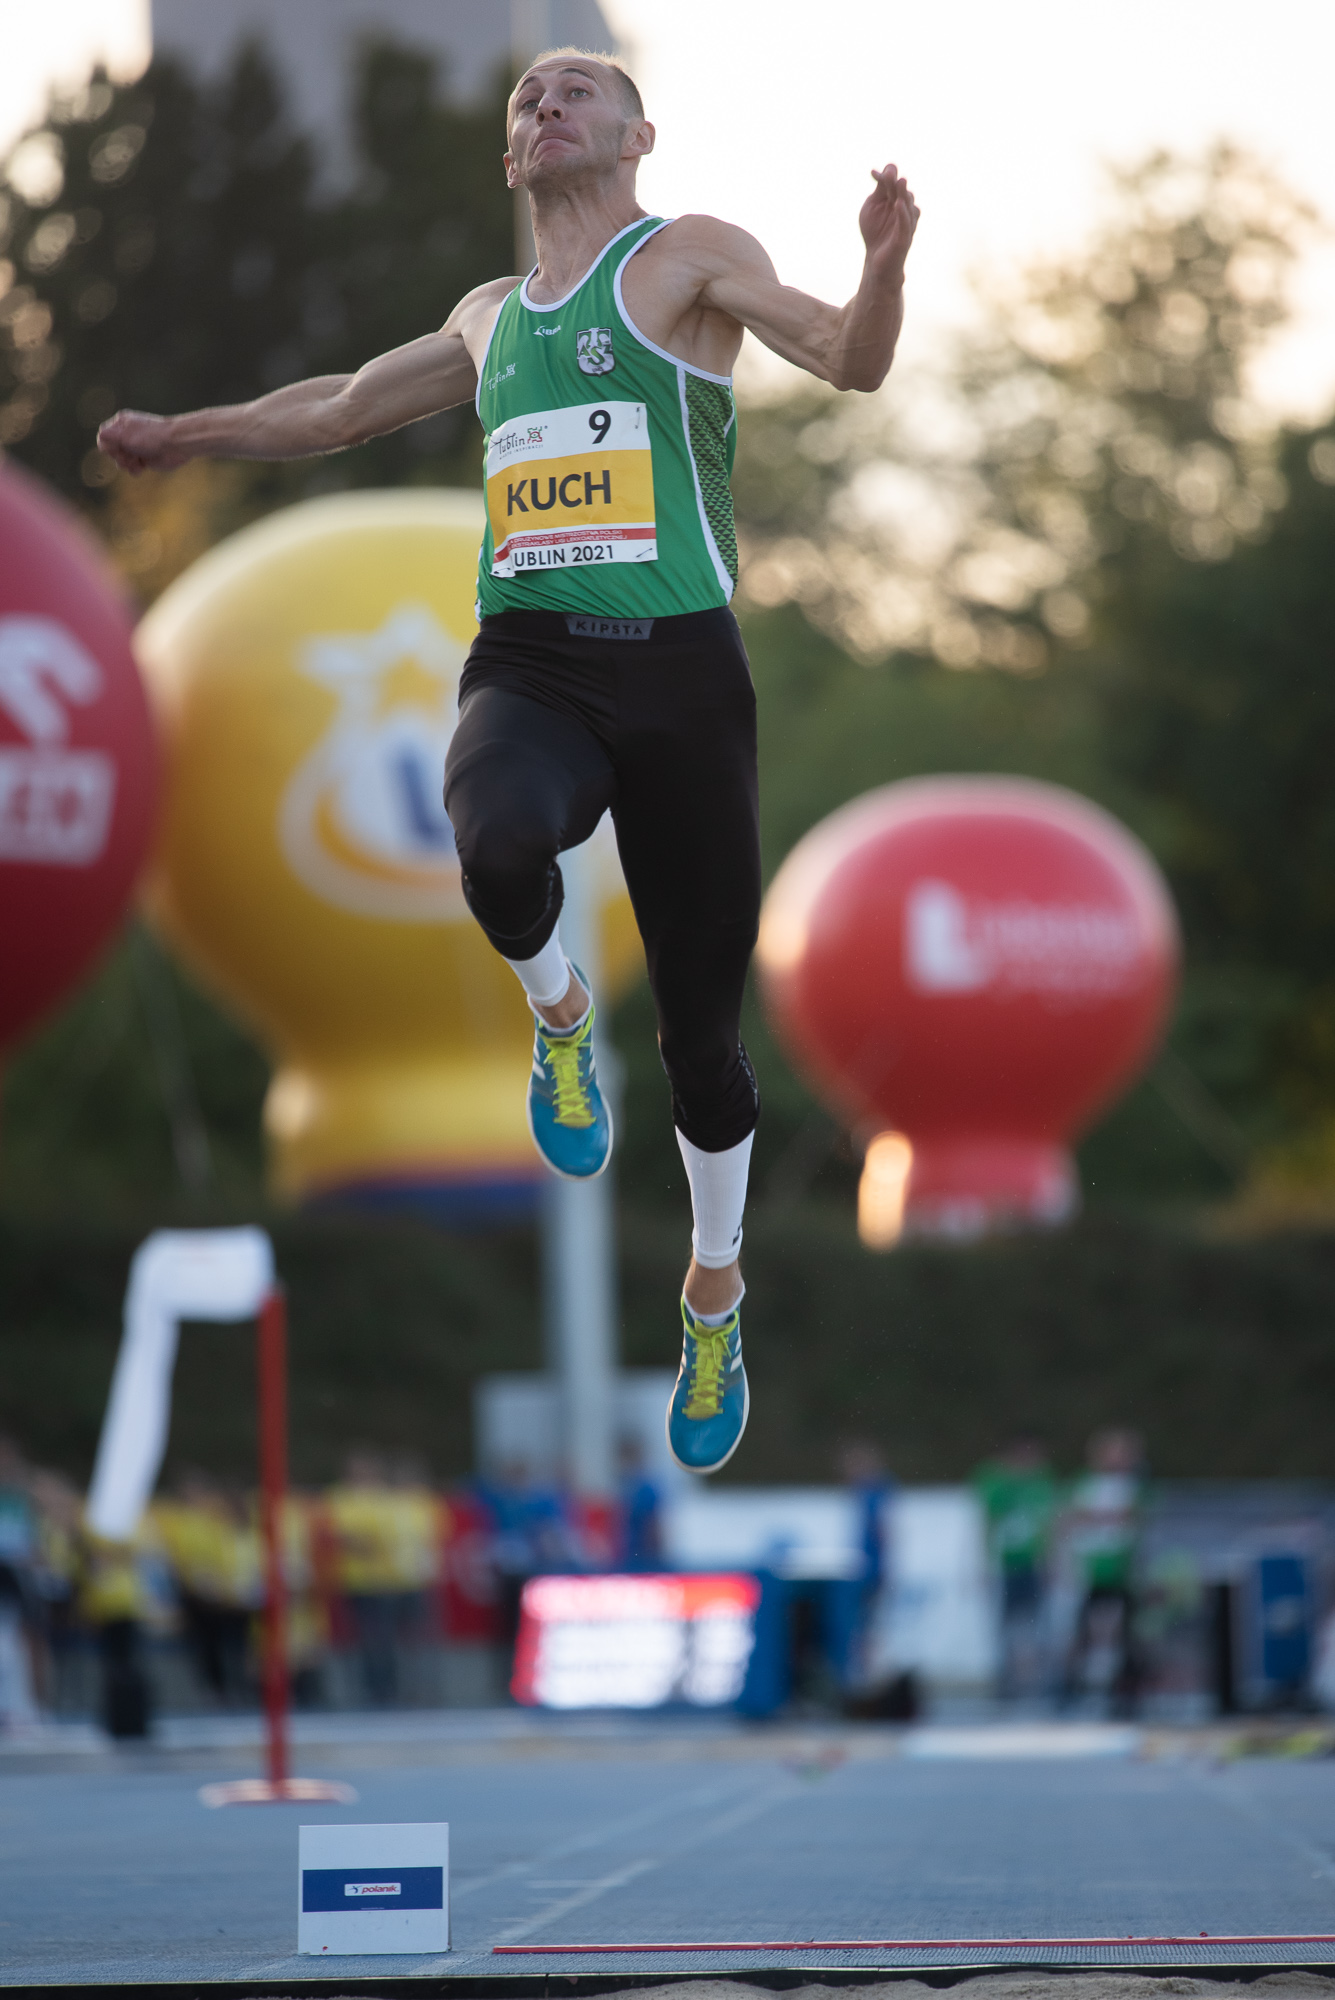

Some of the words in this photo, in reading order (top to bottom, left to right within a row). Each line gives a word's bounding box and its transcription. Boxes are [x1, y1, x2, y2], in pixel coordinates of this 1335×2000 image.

[588, 409, 612, 445] 9
[507, 469, 612, 517] KUCH
[572, 545, 614, 563] 2021
[575, 620, 643, 635] KIPSTA
[361, 1885, 397, 1895] polanik
